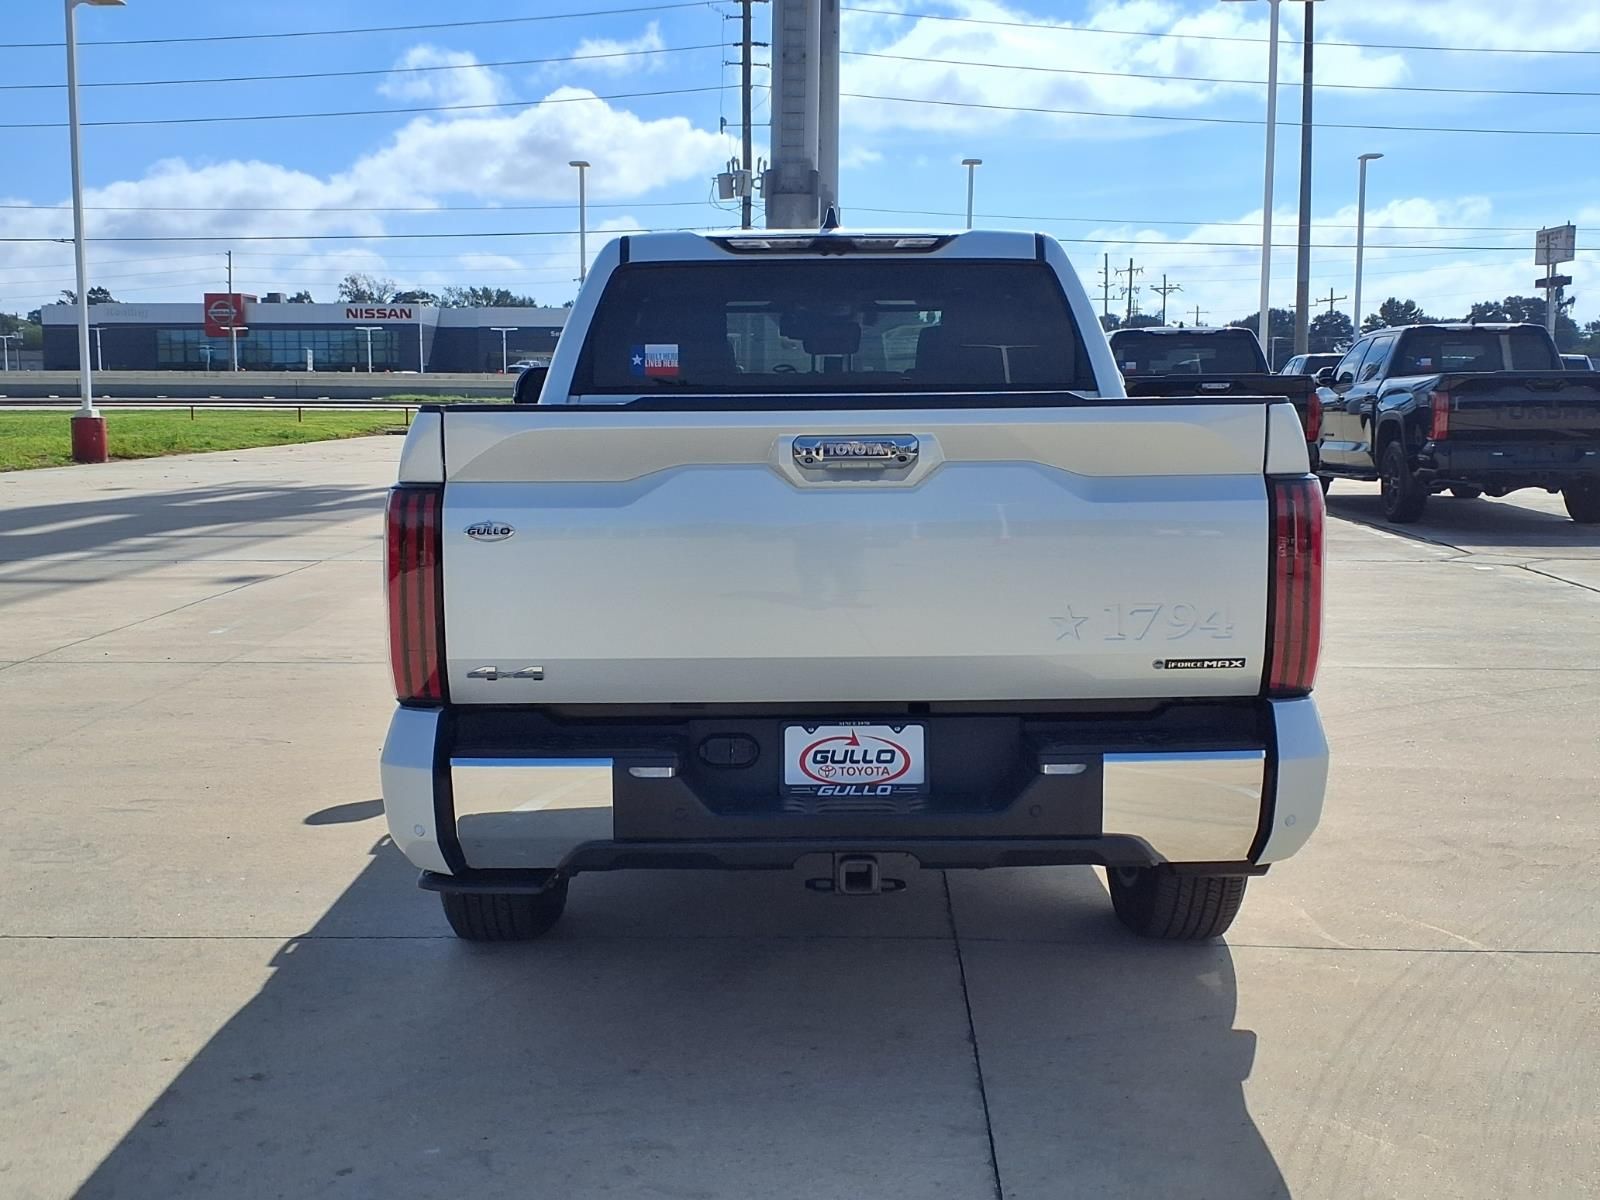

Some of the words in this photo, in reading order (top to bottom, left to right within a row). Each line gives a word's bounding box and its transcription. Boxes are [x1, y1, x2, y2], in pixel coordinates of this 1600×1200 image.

[346, 308, 412, 319] NISSAN
[826, 442, 885, 456] TOYOTA
[467, 527, 511, 535] GULLO
[1103, 602, 1234, 641] 1794
[812, 749, 896, 765] GULLO
[838, 766, 890, 776] TOYOTA
[817, 785, 892, 796] GULLO
